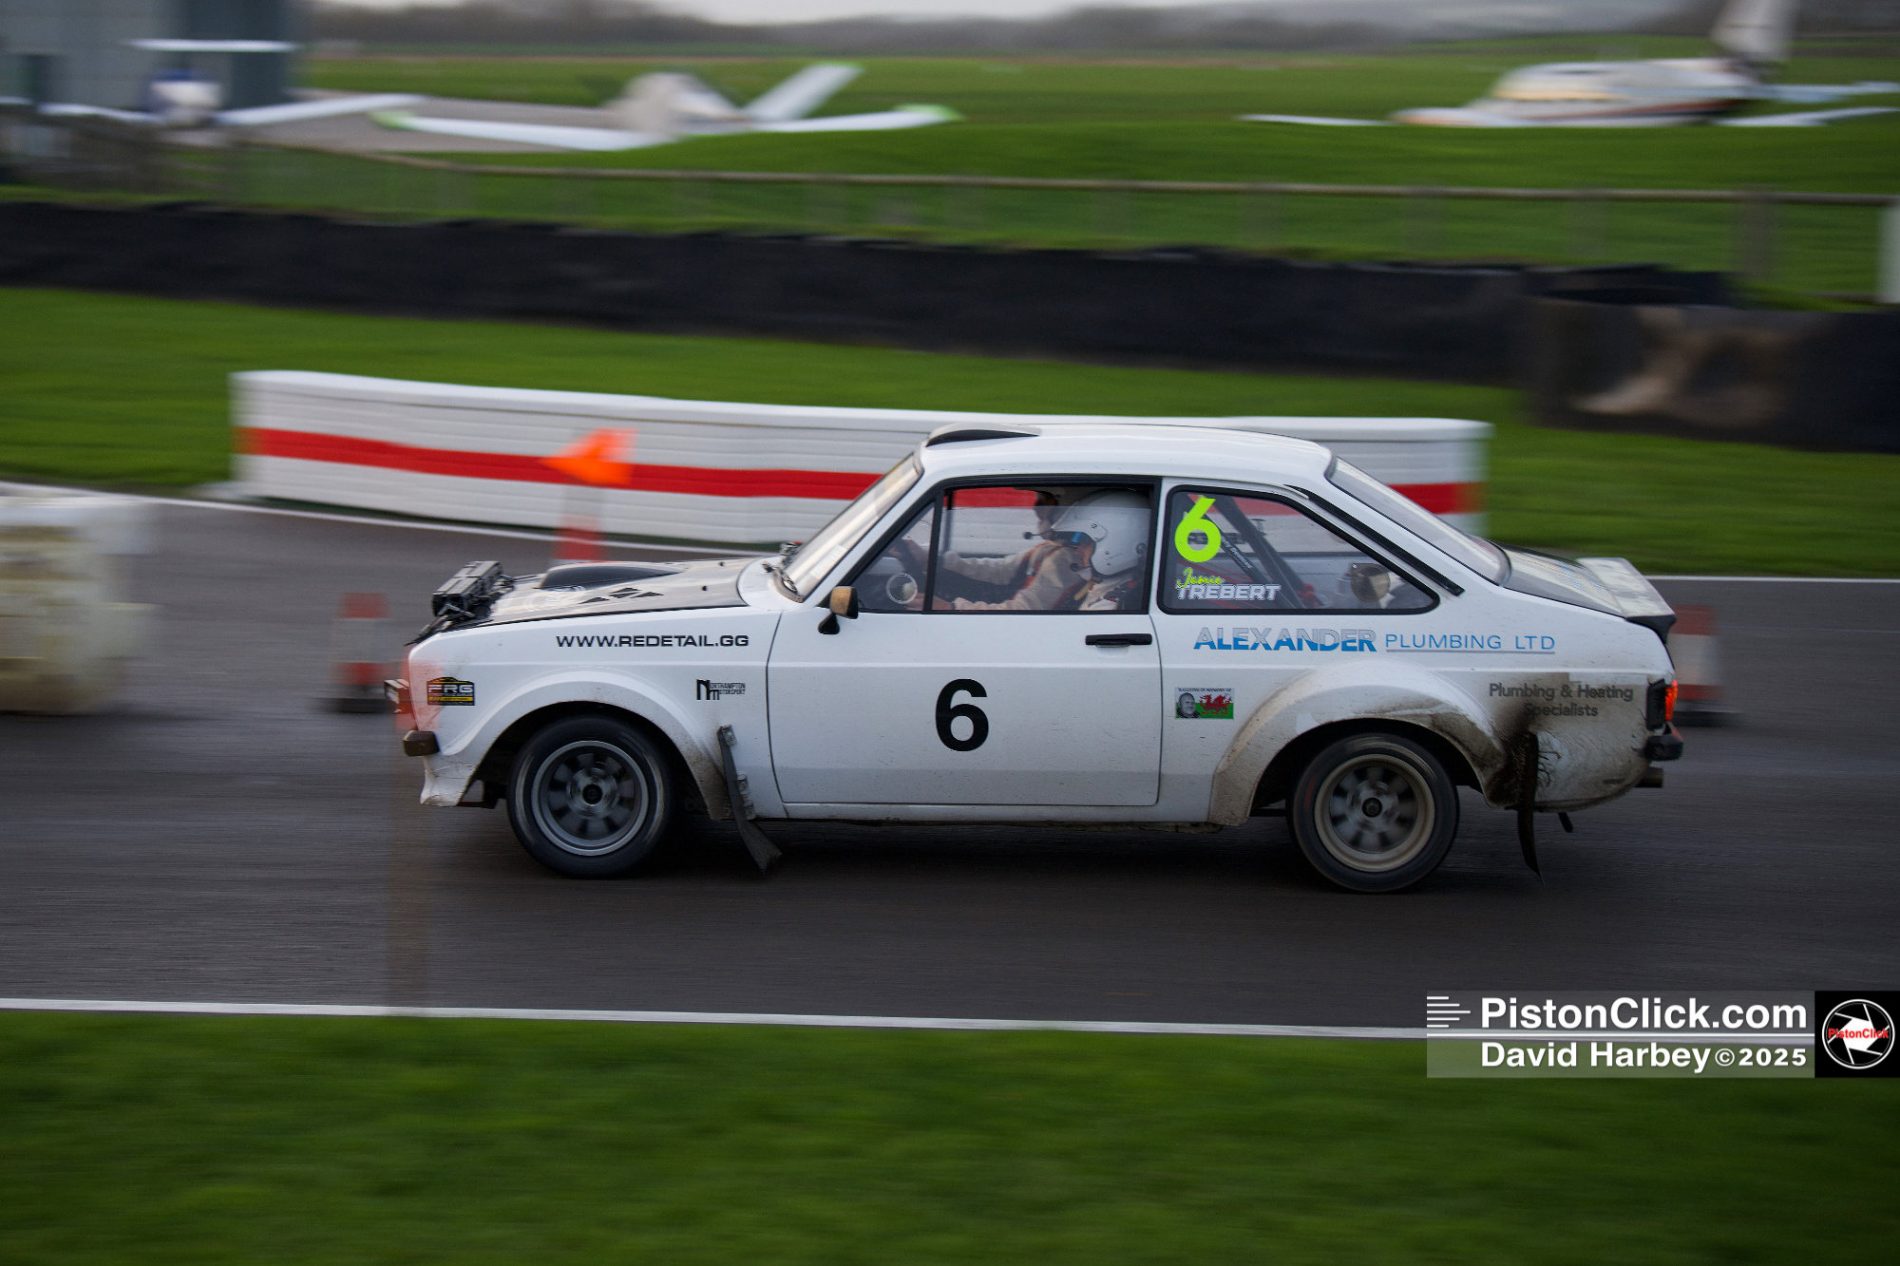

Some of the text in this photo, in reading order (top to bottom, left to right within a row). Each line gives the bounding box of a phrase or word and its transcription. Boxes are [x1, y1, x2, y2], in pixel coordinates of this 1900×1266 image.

[1174, 495, 1221, 563] 6
[1176, 584, 1281, 600] TREBERT
[556, 635, 749, 648] WWW.REDETAIL.GG
[1193, 627, 1555, 652] ALEXANDER PLUMBING LTD
[1489, 683, 1634, 702] Plumbing & Heating
[935, 678, 989, 752] 6
[1523, 703, 1599, 717] Specialists
